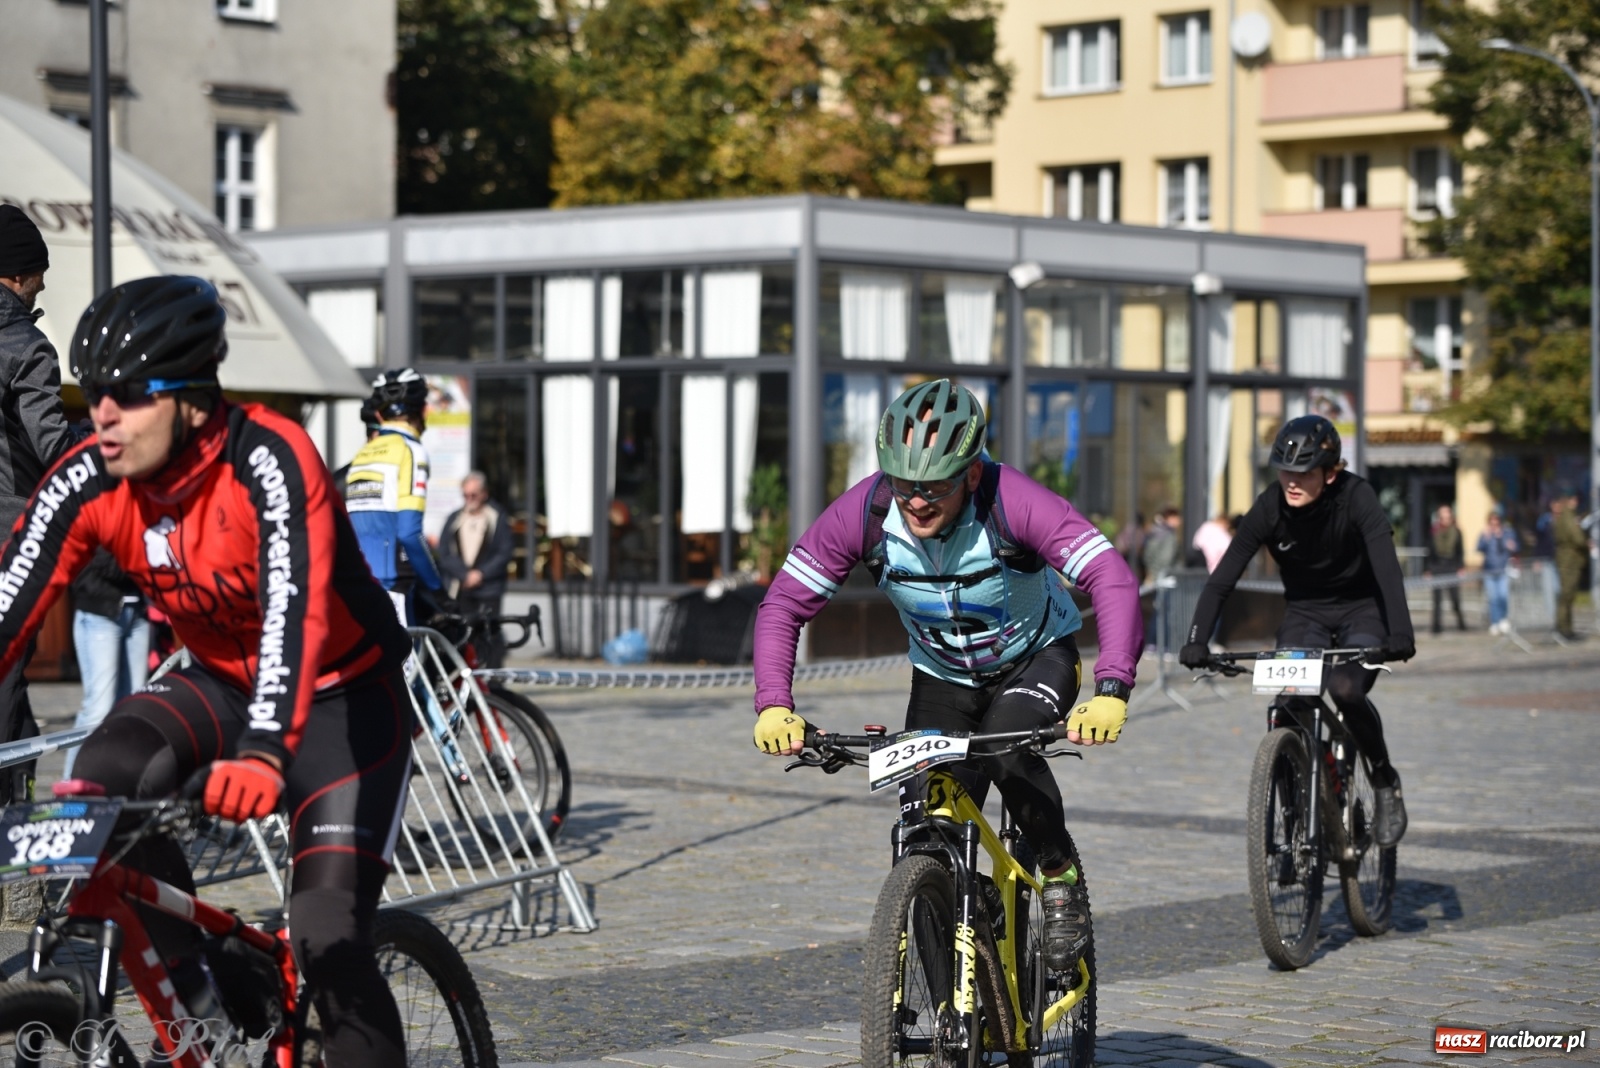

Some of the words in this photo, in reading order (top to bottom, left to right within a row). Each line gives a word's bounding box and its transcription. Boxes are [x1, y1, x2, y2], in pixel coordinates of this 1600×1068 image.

[1266, 666, 1307, 680] 1491
[1002, 687, 1060, 716] SCOTT
[885, 739, 951, 768] 2340
[9, 831, 75, 866] 168
